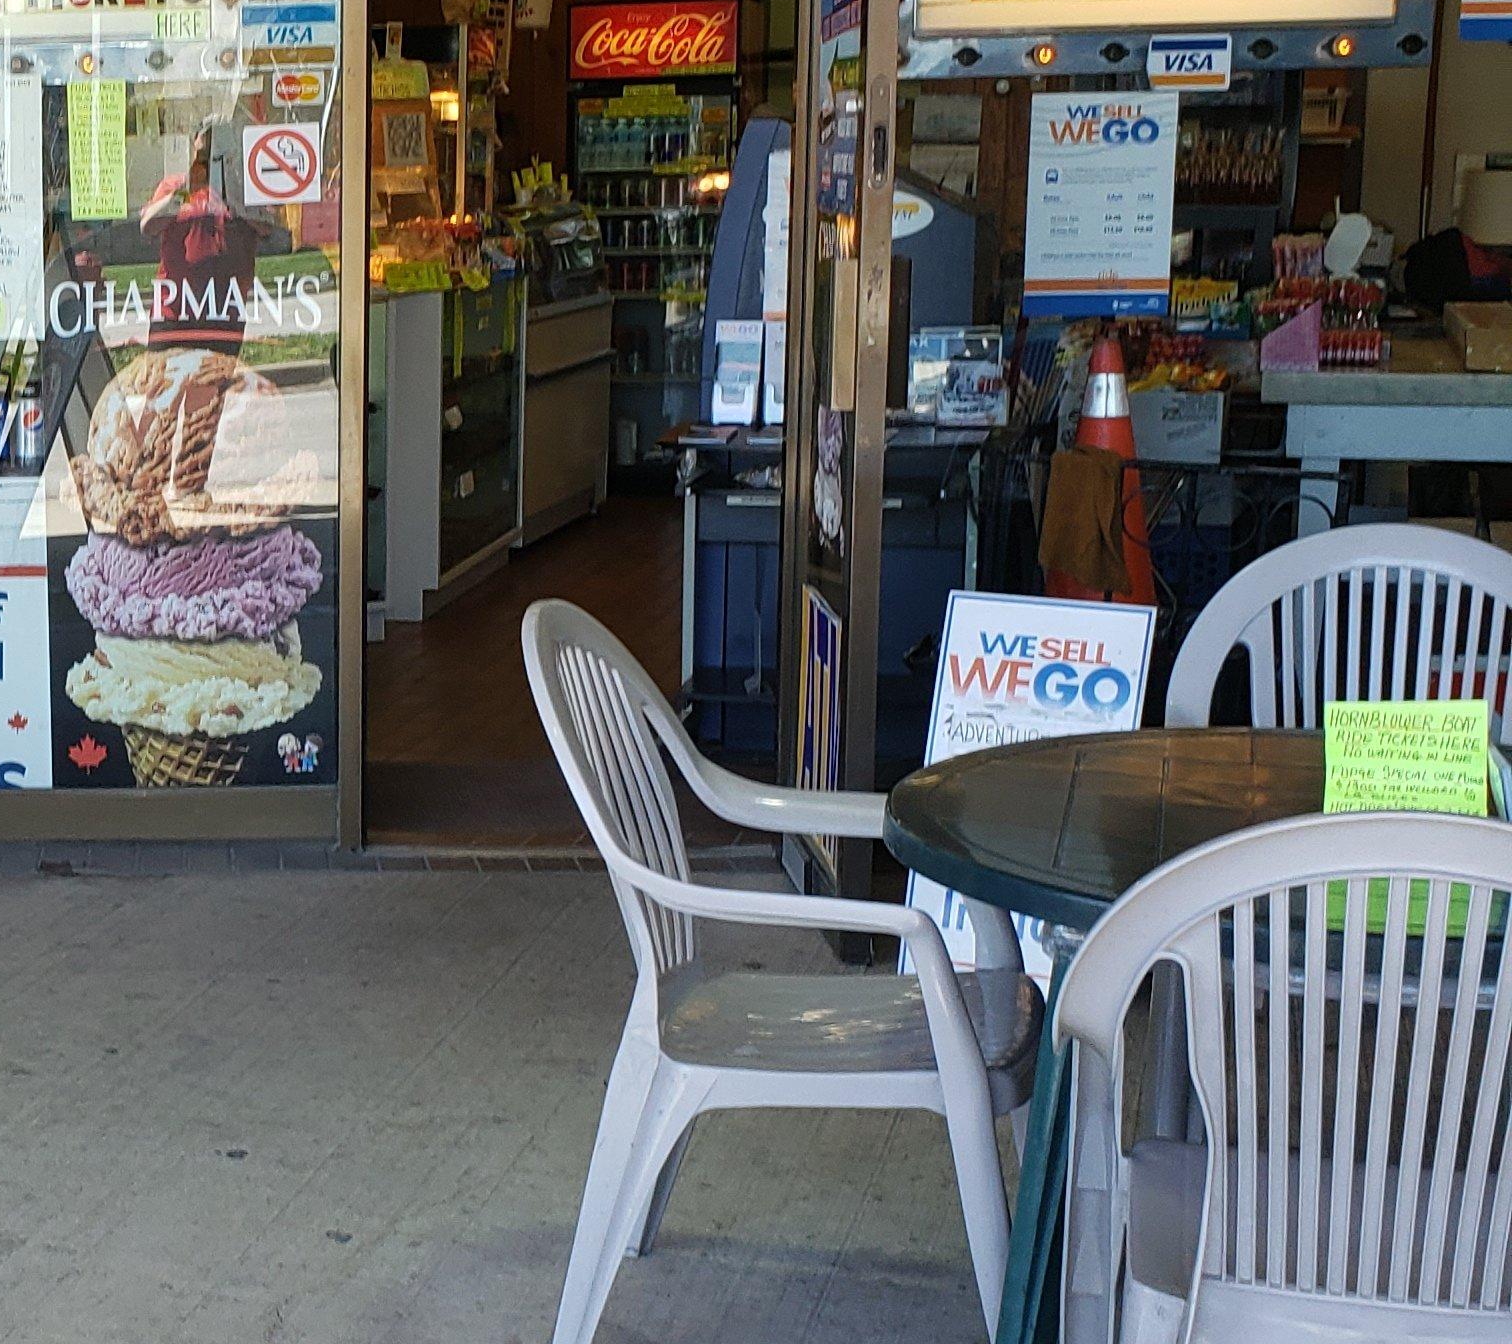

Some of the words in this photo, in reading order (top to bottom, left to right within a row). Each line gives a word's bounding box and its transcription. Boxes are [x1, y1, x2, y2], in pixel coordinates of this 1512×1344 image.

[157, 12, 199, 37] HERE
[267, 25, 314, 45] VISA
[575, 11, 734, 67] Coca-Cola
[1161, 52, 1215, 74] VISA
[1049, 116, 1160, 146] WEGO
[48, 269, 323, 340] CHAPMAN'S
[948, 652, 1131, 713] WEGO
[1329, 708, 1434, 731] HORNBLOWER
[1441, 713, 1478, 734] BOAT
[1439, 734, 1481, 752] HERE
